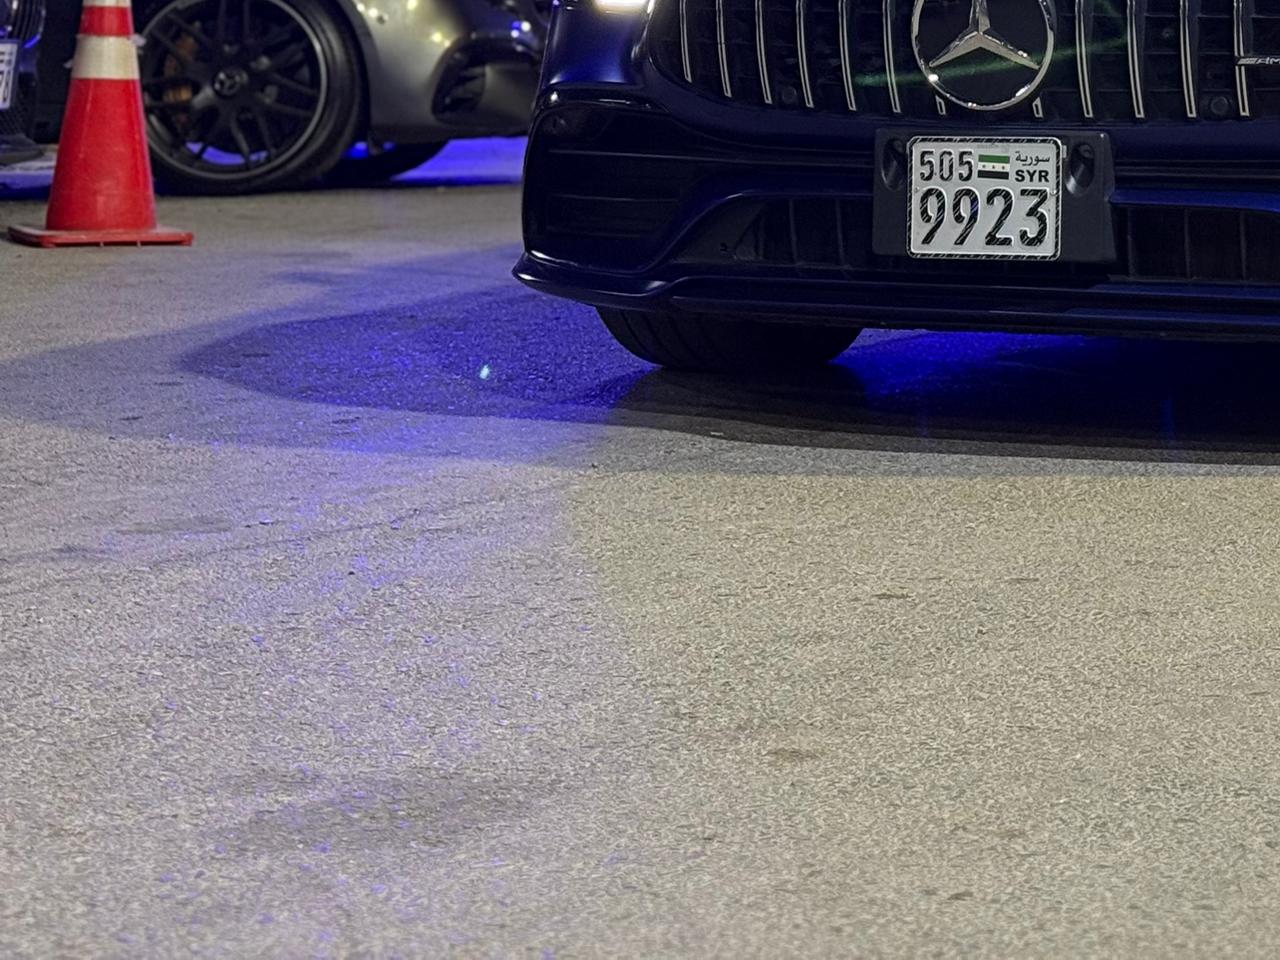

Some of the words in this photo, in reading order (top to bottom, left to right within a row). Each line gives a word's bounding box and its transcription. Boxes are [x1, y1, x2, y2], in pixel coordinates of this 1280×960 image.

[920, 150, 973, 181] 505
[1015, 150, 1051, 165] سورية
[1014, 170, 1050, 182] SYR
[919, 188, 1049, 246] 9923
